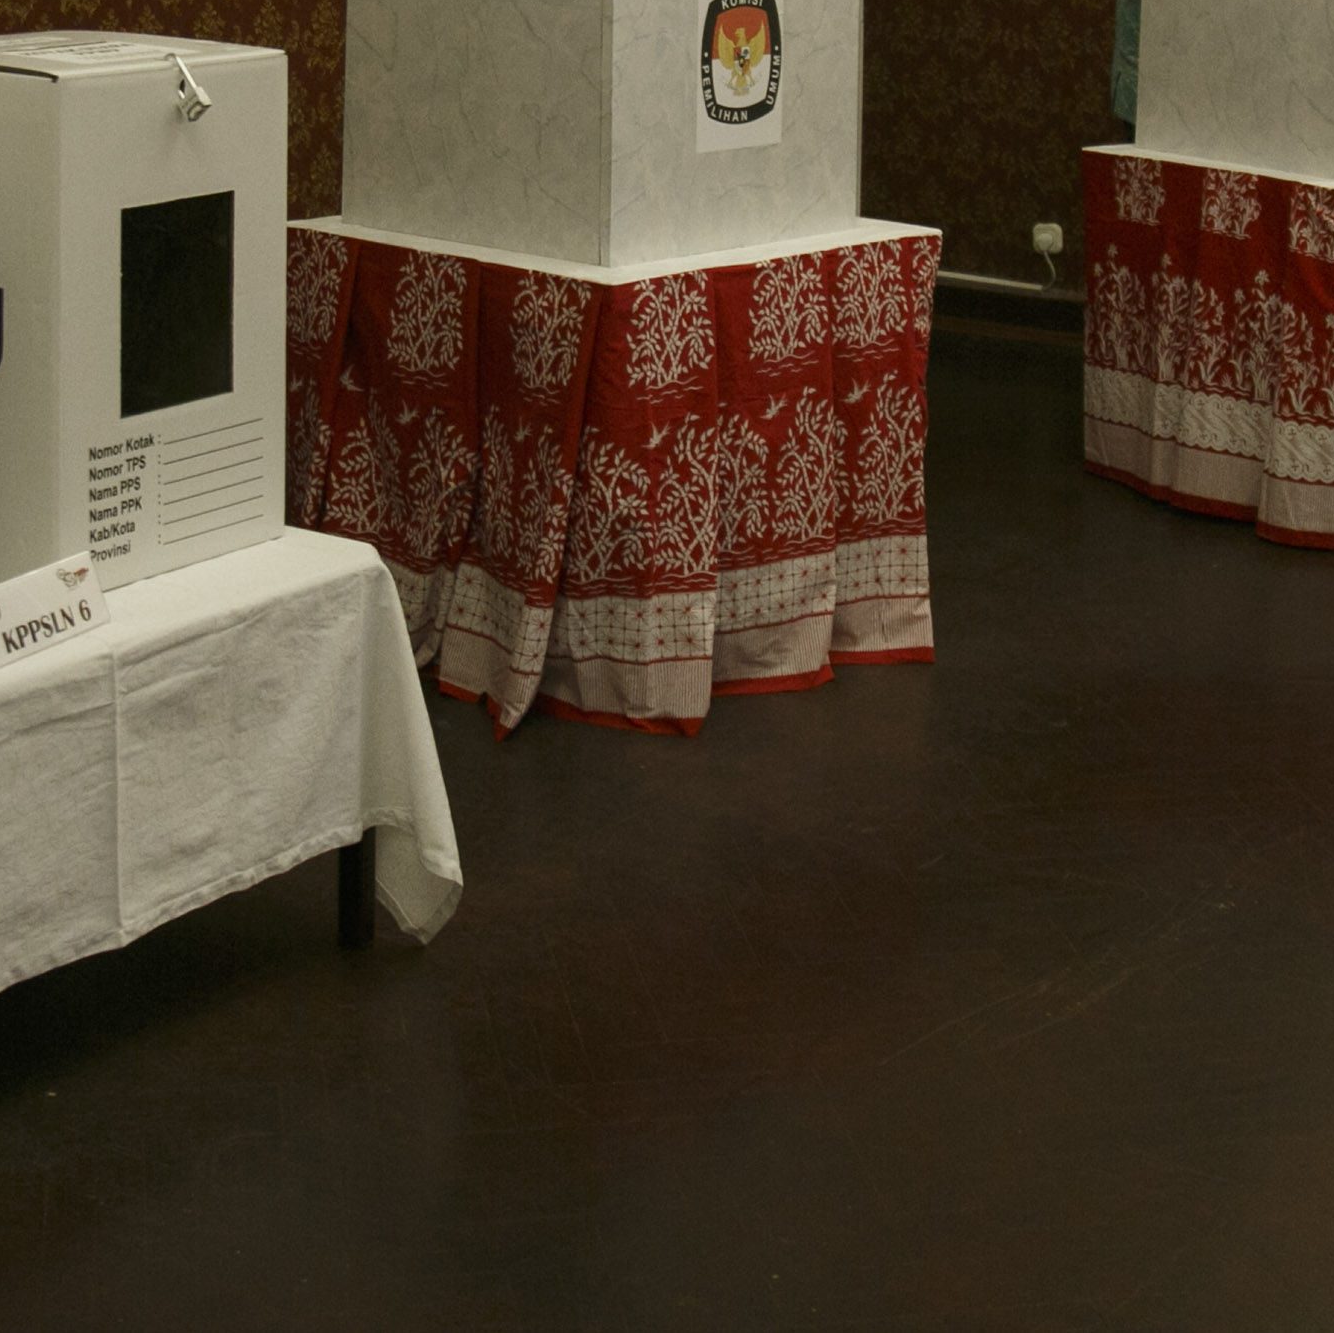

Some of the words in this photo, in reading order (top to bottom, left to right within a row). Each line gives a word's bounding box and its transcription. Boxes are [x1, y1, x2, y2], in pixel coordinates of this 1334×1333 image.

[702, 65, 749, 122] PEMILIHAN
[765, 54, 781, 106] UMUM
[89, 442, 123, 461] Nomor
[125, 433, 155, 451] Kotak
[89, 463, 123, 482] Nomor
[126, 455, 146, 472] TPS
[89, 485, 118, 502] Nama
[120, 477, 141, 494] PPS
[89, 505, 118, 523] Nama
[121, 497, 142, 516] PPK
[89, 521, 136, 543] Kab/Kota
[90, 540, 131, 562] Provinsi
[2, 606, 75, 654] KPPSLN
[78, 599, 92, 622] 6
